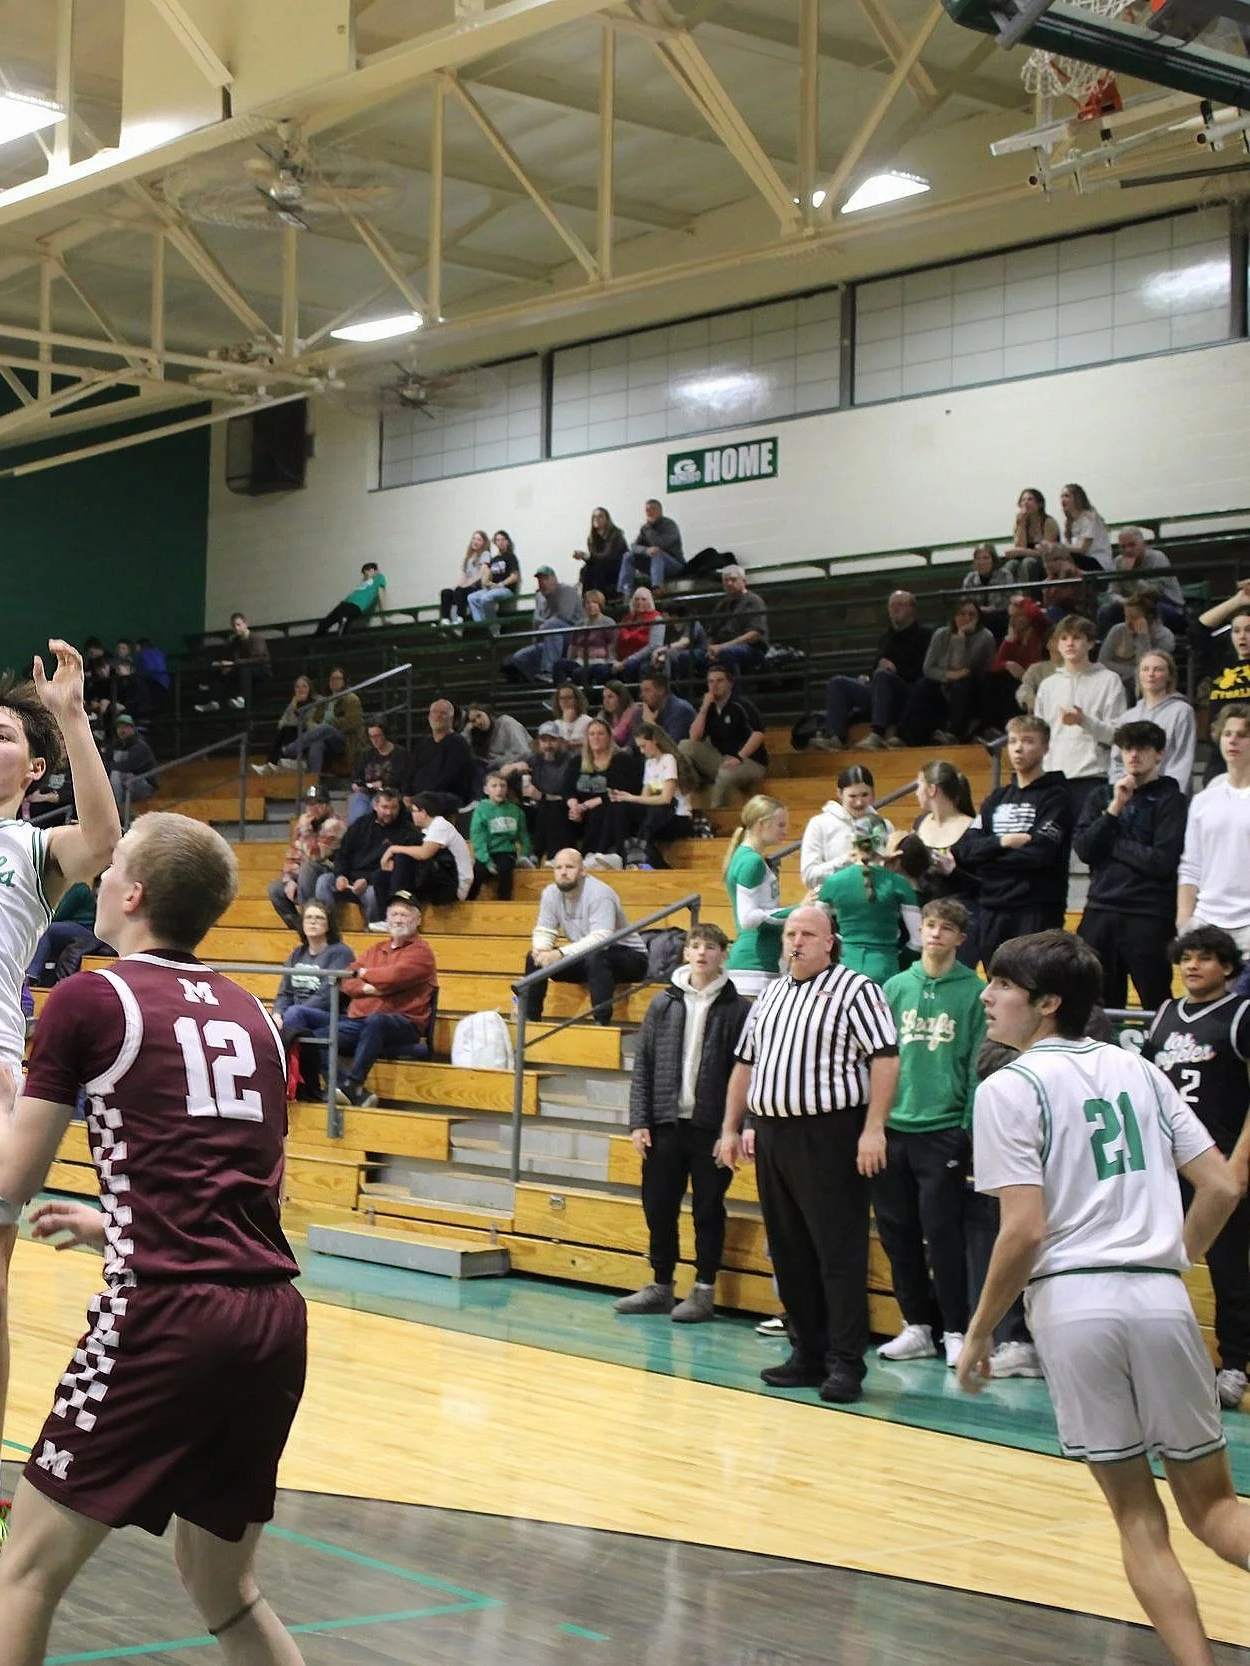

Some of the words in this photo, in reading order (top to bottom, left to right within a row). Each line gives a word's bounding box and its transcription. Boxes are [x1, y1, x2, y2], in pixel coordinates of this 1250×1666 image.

[704, 441, 774, 484] HOME
[176, 977, 220, 1006] M
[173, 1016, 264, 1123] 12
[1180, 1069, 1201, 1103] 2
[1083, 1092, 1147, 1181] 21
[35, 1439, 75, 1480] M
